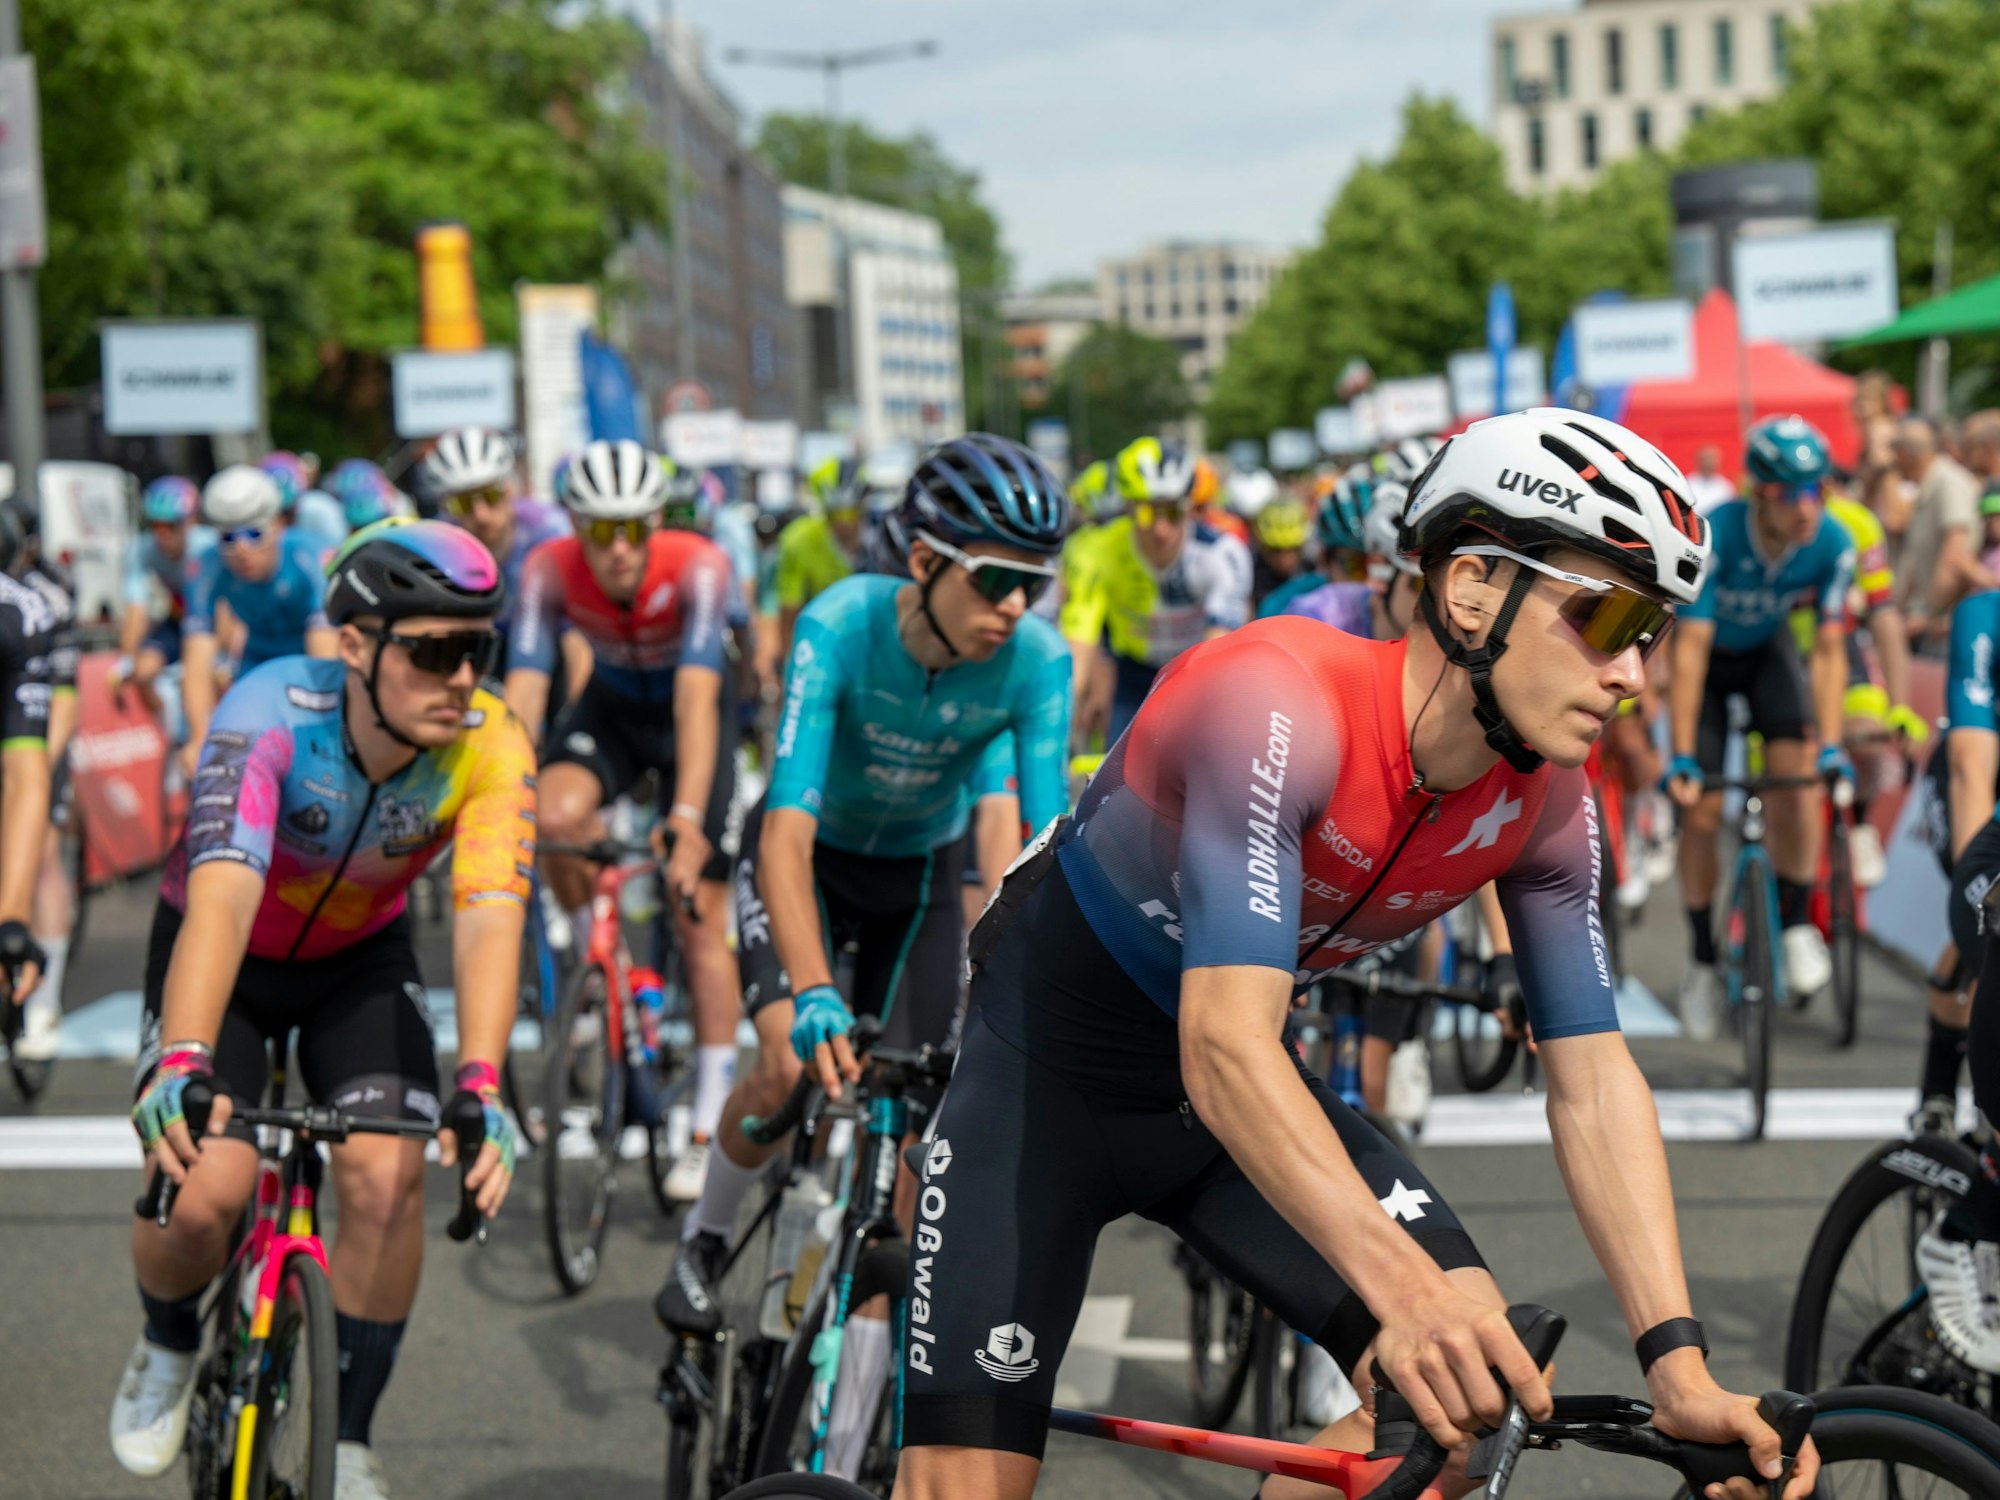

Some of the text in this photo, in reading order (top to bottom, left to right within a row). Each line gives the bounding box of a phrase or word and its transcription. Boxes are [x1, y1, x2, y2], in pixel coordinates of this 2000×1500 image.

[1496, 468, 1585, 515] uvex
[1248, 711, 1293, 924] RADHALLE.com
[1582, 795, 1611, 989] RADHALLE.com
